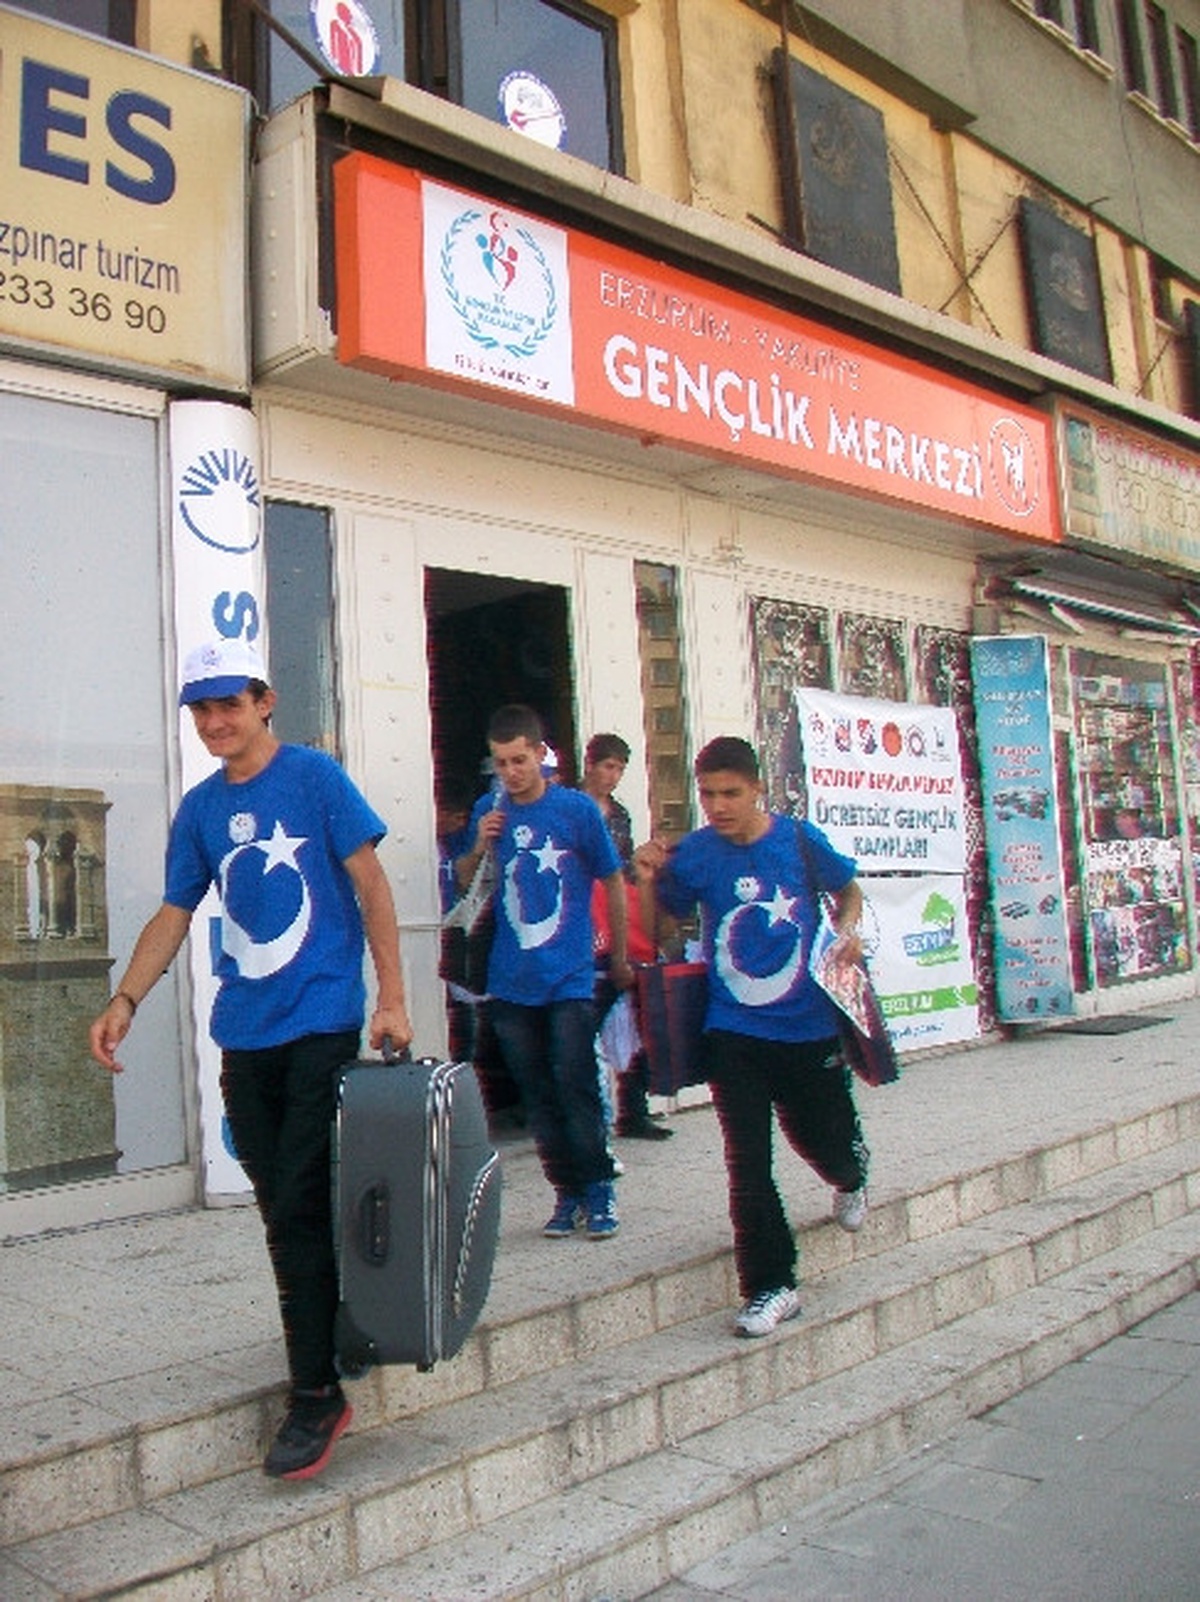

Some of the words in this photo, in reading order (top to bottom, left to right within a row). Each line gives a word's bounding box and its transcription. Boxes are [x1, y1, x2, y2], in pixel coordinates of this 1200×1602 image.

[97, 239, 180, 293] turizm
[69, 287, 112, 322] 36
[125, 300, 166, 334] 90
[600, 271, 732, 344] ERZURUM
[603, 334, 815, 450] GENÇLİK
[827, 404, 984, 499] MERKEZİ
[816, 797, 890, 827] ÜCRETSİZ
[895, 805, 957, 833] GENÇLİK
[853, 836, 928, 858] KAMPLARI
